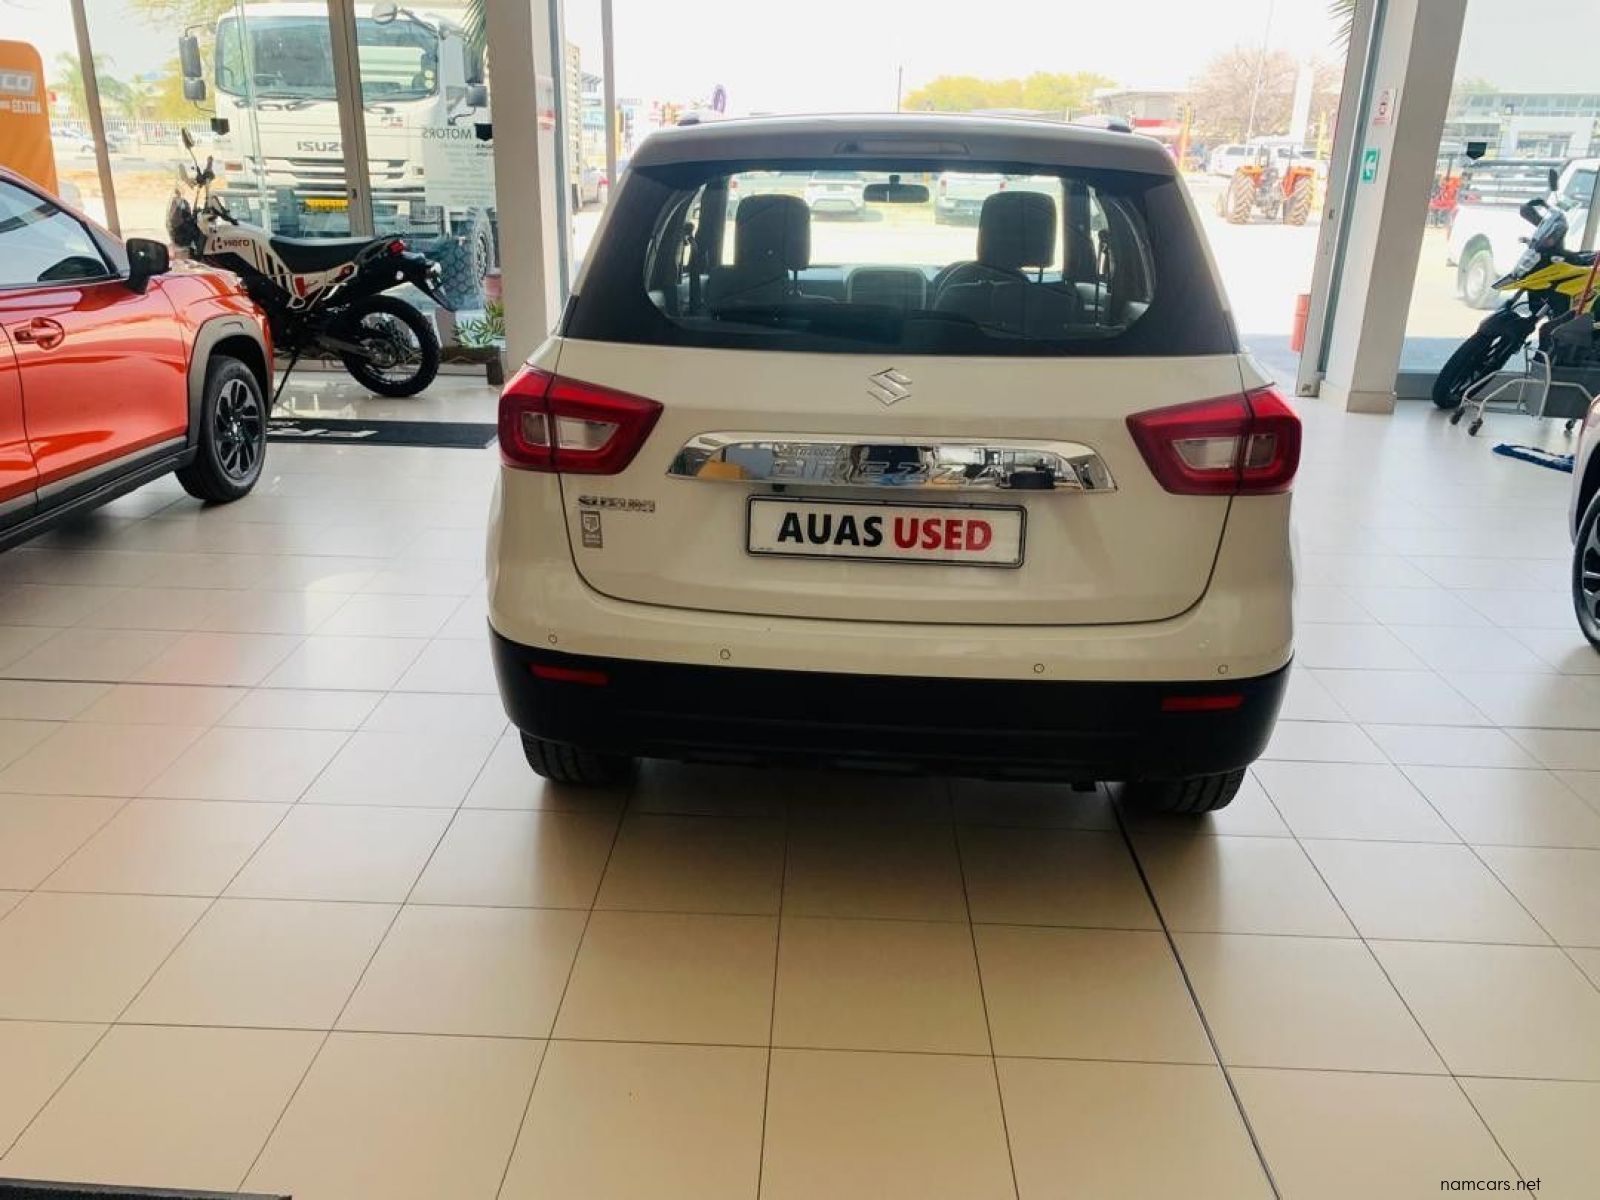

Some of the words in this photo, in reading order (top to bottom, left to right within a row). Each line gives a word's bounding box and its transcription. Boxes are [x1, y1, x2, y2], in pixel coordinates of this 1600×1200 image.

[297, 141, 341, 152] ISUZ
[777, 512, 883, 547] AUAS
[894, 518, 992, 551] USED
